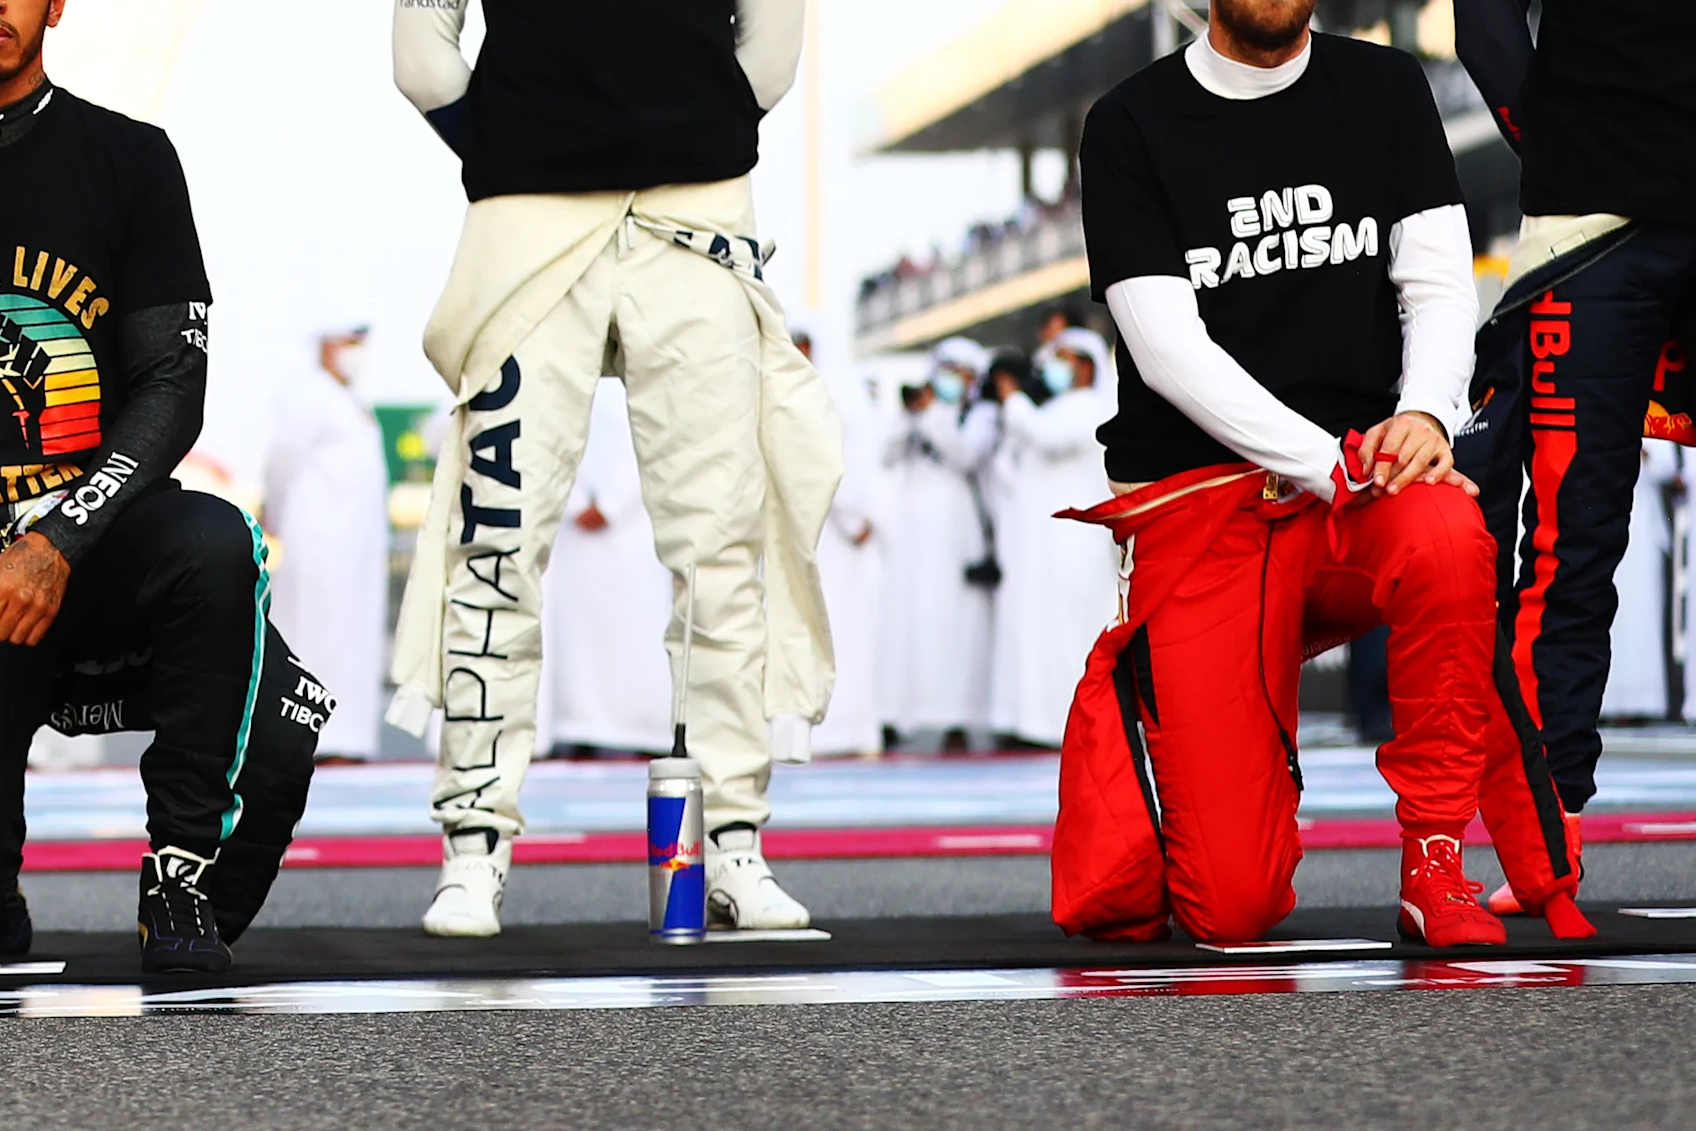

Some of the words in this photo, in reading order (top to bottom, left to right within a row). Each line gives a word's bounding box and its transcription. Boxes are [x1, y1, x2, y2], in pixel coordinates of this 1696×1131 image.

[1226, 184, 1334, 239] END
[13, 244, 110, 330] LIVES
[1184, 216, 1379, 290] RACISM
[1529, 320, 1577, 427] Bull
[61, 451, 139, 526] INEOS
[281, 697, 324, 733] TIBC
[677, 842, 700, 856] Bull
